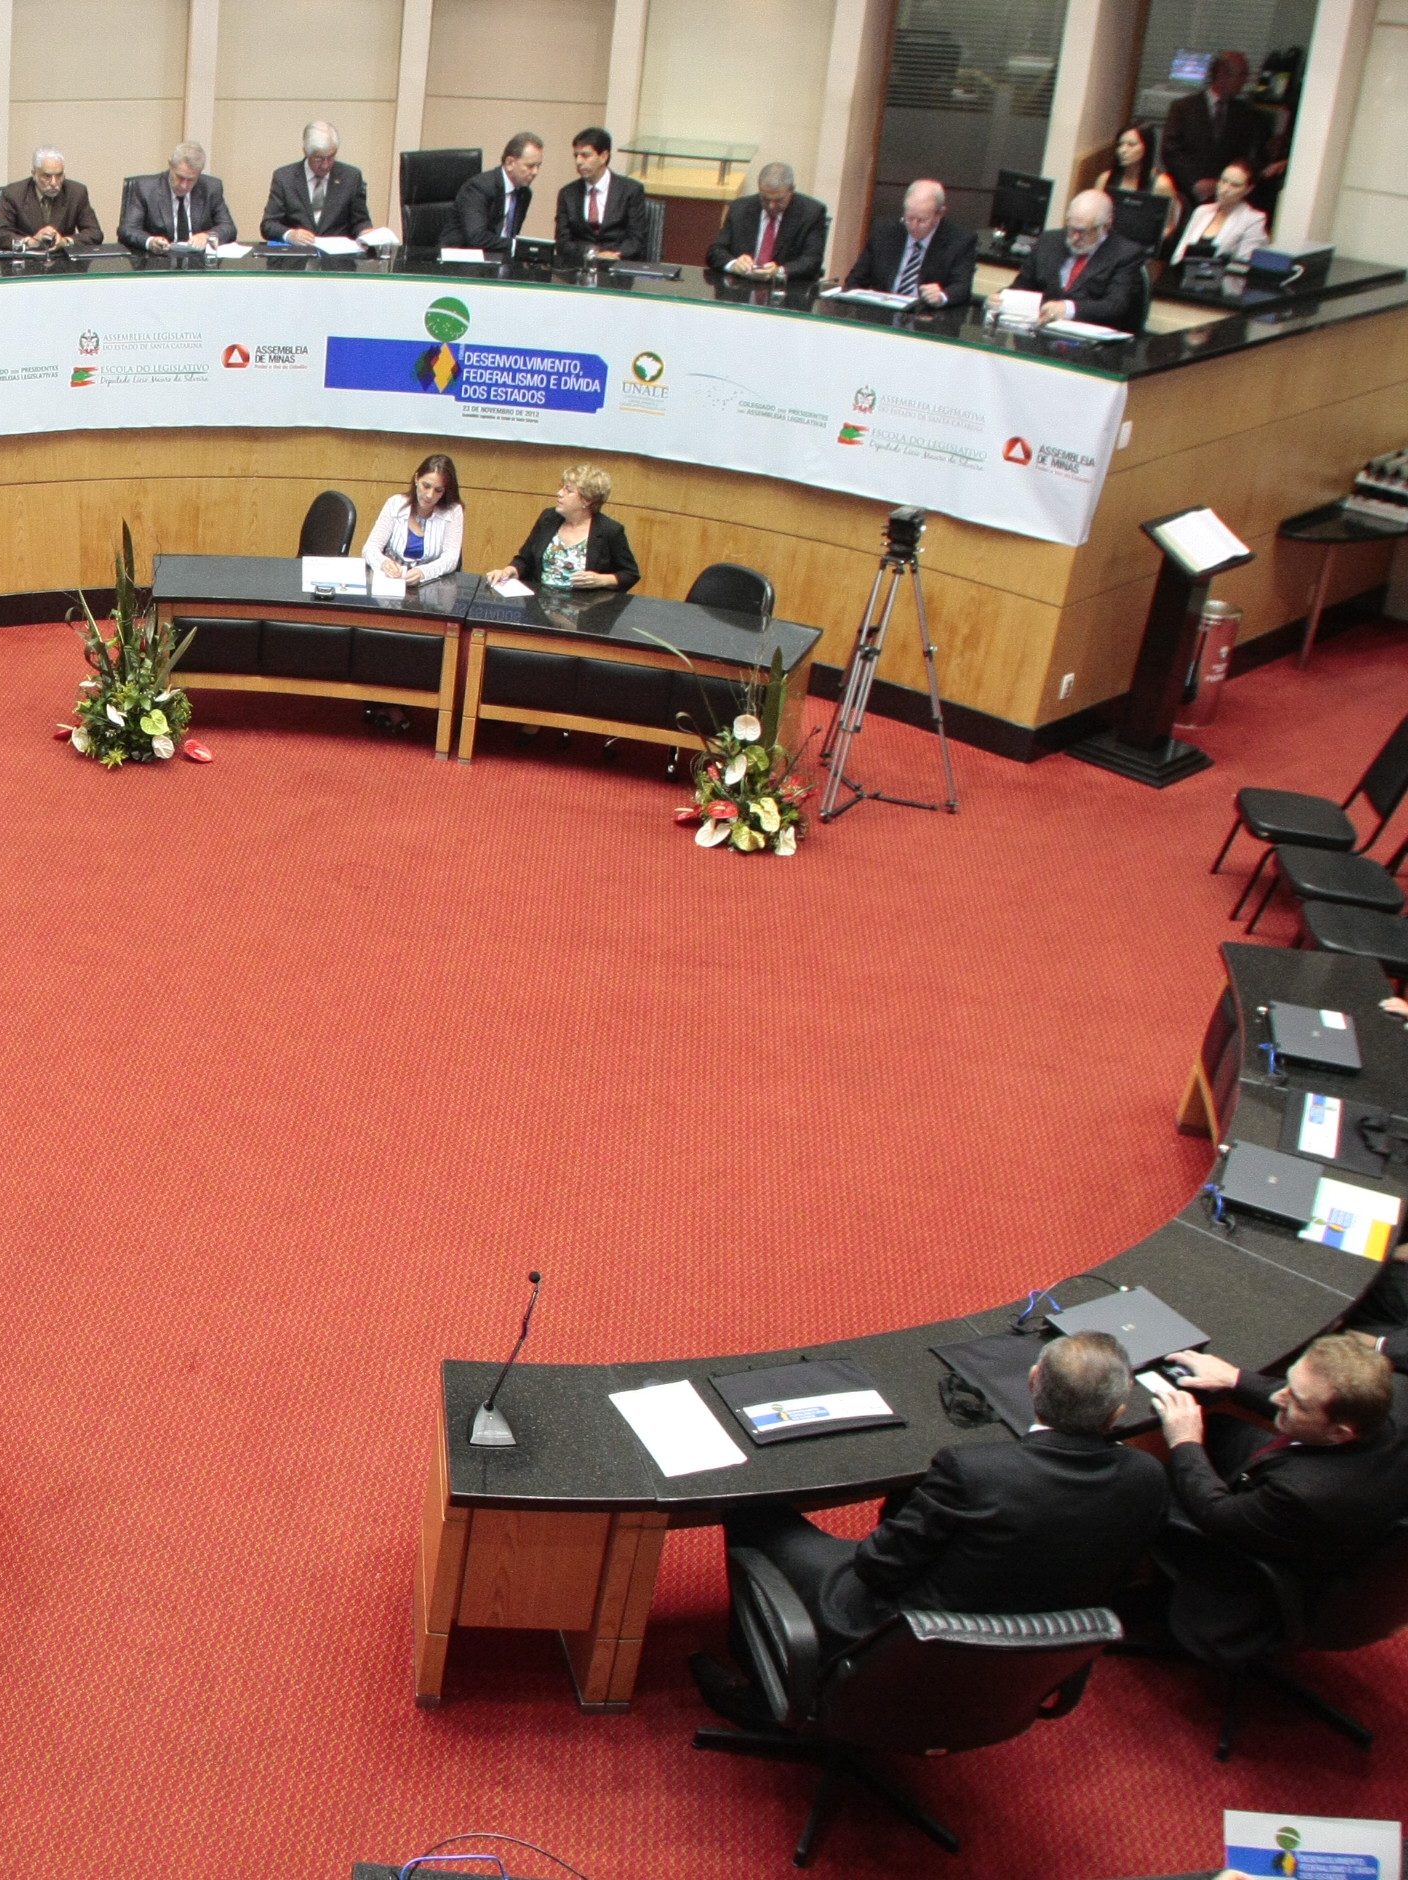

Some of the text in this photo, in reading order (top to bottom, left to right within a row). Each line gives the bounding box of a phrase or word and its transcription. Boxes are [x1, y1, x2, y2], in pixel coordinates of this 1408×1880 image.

[103, 331, 202, 341] ASSEMBLEIA LEGISLATIVA
[255, 345, 308, 355] ASSEMBLEIA
[255, 354, 296, 363] DE MINAS
[464, 351, 584, 376] DESENVOLVIMENTO,
[21, 365, 59, 373] PRESIDENTES
[100, 363, 210, 374] ESCOLA DO LEGISLATIVO
[21, 372, 59, 381] LEGISLATIVAS
[462, 368, 602, 392] FEDERALISMO E DÍVIDA
[461, 384, 546, 404] DOS ESTADOS
[622, 381, 669, 399] UNALE
[480, 406, 514, 415] NOVEMBRO
[1038, 444, 1096, 467] ASSEMBLEIA
[1037, 455, 1047, 465] DE
[1051, 457, 1080, 474] MINAS
